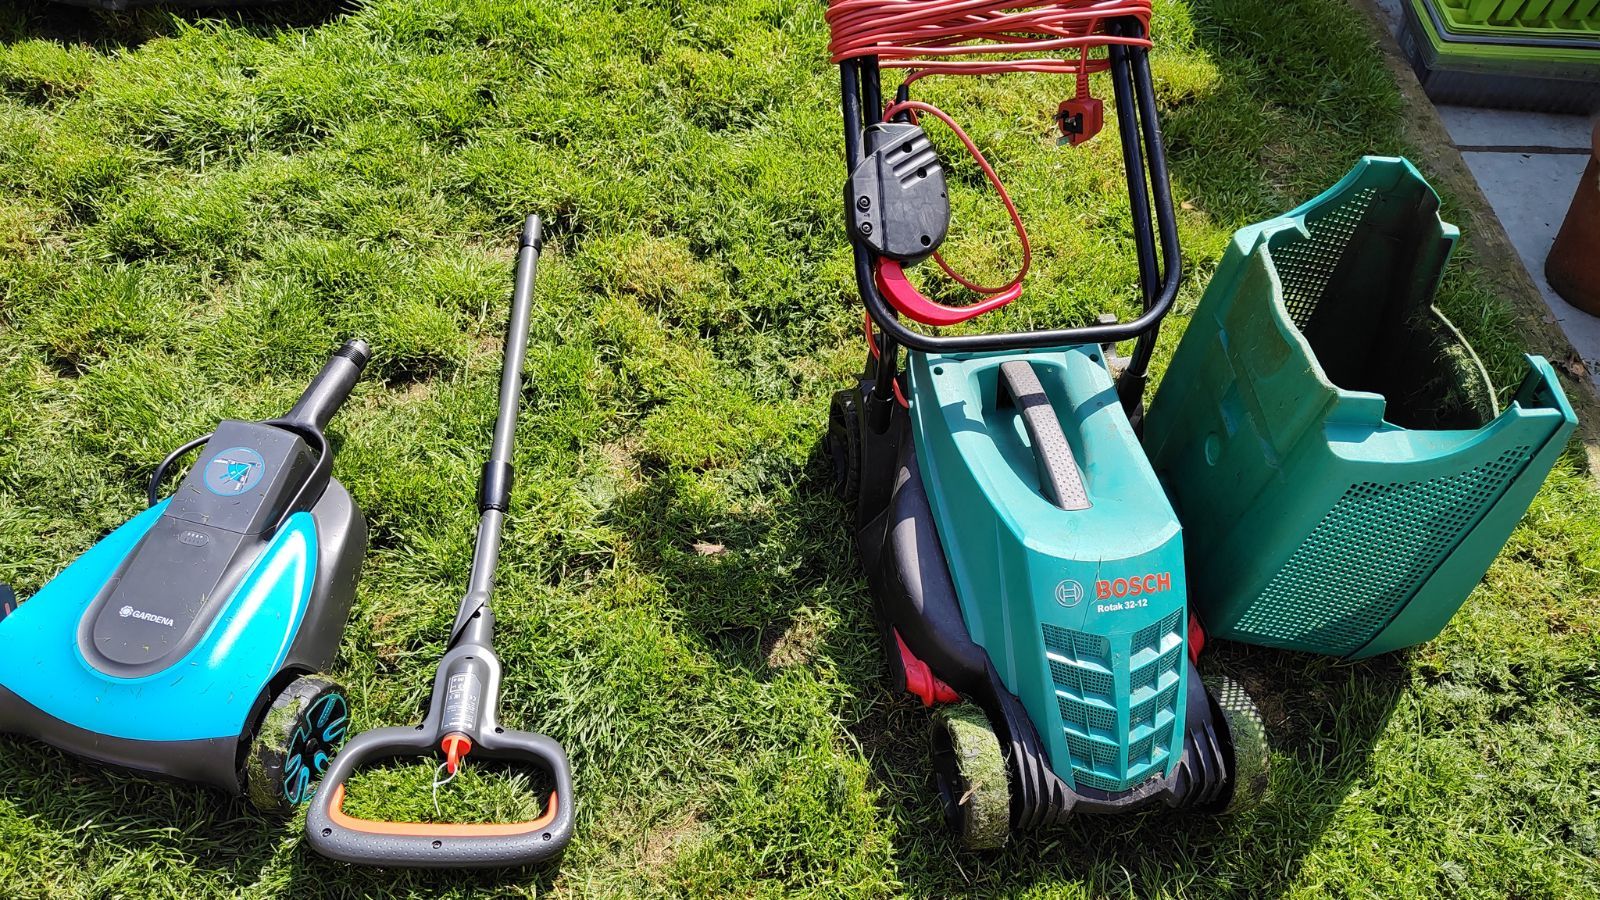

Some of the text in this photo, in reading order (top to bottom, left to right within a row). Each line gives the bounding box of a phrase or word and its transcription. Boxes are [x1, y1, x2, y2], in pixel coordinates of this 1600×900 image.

[1096, 572, 1170, 599] BOSCH
[1097, 599, 1148, 613] Rotak 32-12
[132, 610, 173, 626] GARDENA
